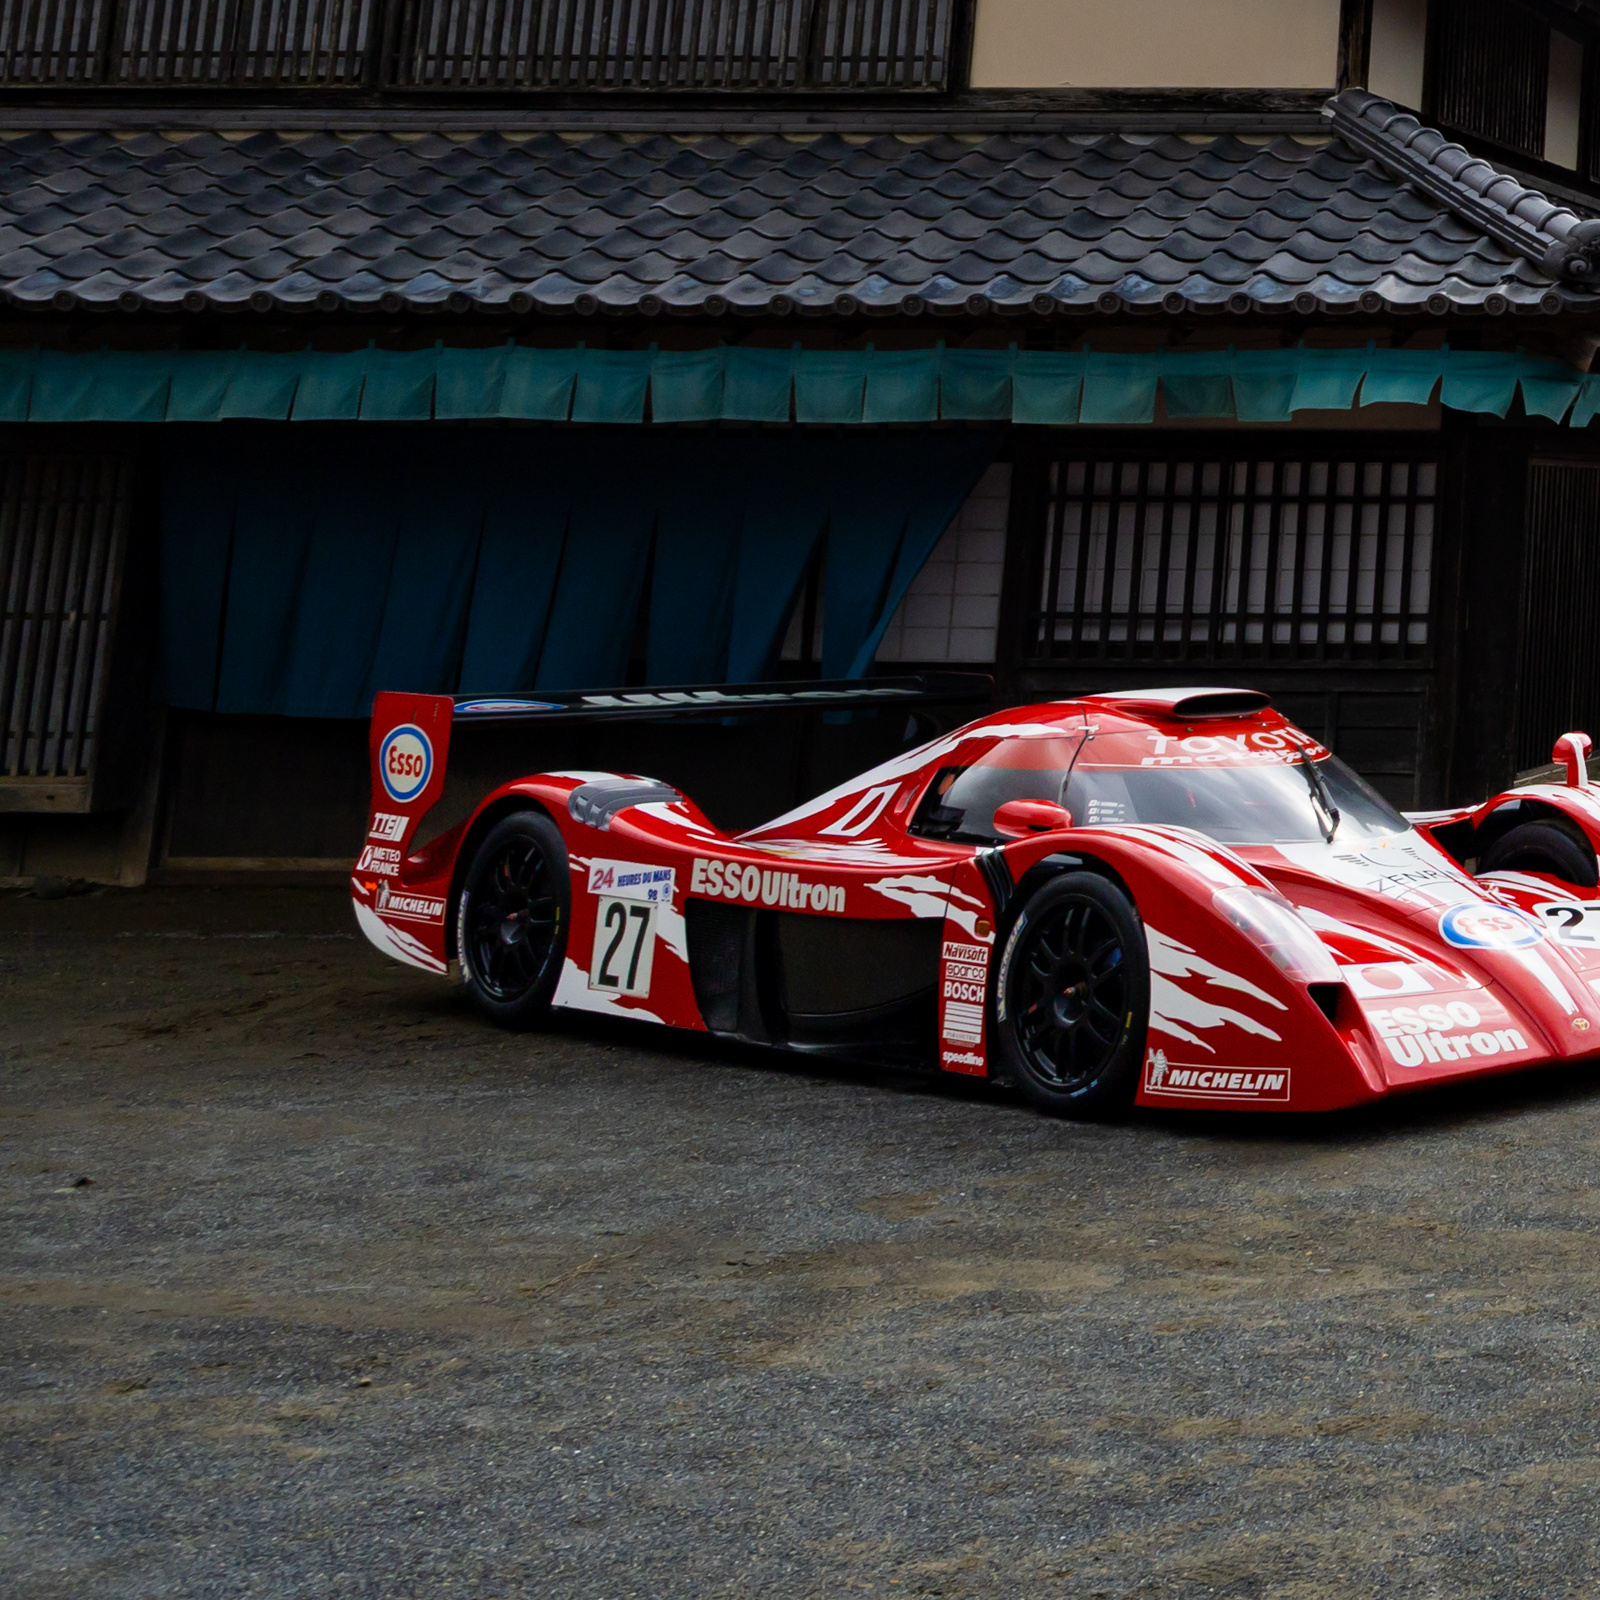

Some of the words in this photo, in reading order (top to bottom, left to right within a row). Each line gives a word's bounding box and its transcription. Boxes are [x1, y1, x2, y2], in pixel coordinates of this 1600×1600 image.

[1147, 726, 1315, 754] TOYOTA
[372, 847, 401, 862] METEO
[370, 860, 400, 876] FRANCE
[590, 866, 615, 891] 24
[617, 871, 641, 888] HEURES
[642, 871, 652, 884] DU
[653, 868, 672, 882] MANS
[388, 896, 444, 916] MICHELIN
[597, 901, 651, 990] 27
[944, 943, 987, 962] Navisoft
[946, 963, 985, 980] sparco
[943, 981, 986, 1003] BOSCH
[1365, 1000, 1482, 1038] ESSO
[1383, 1025, 1529, 1068] Ultron
[942, 1051, 985, 1067] speedline
[1167, 1067, 1286, 1092] MICHELIN
